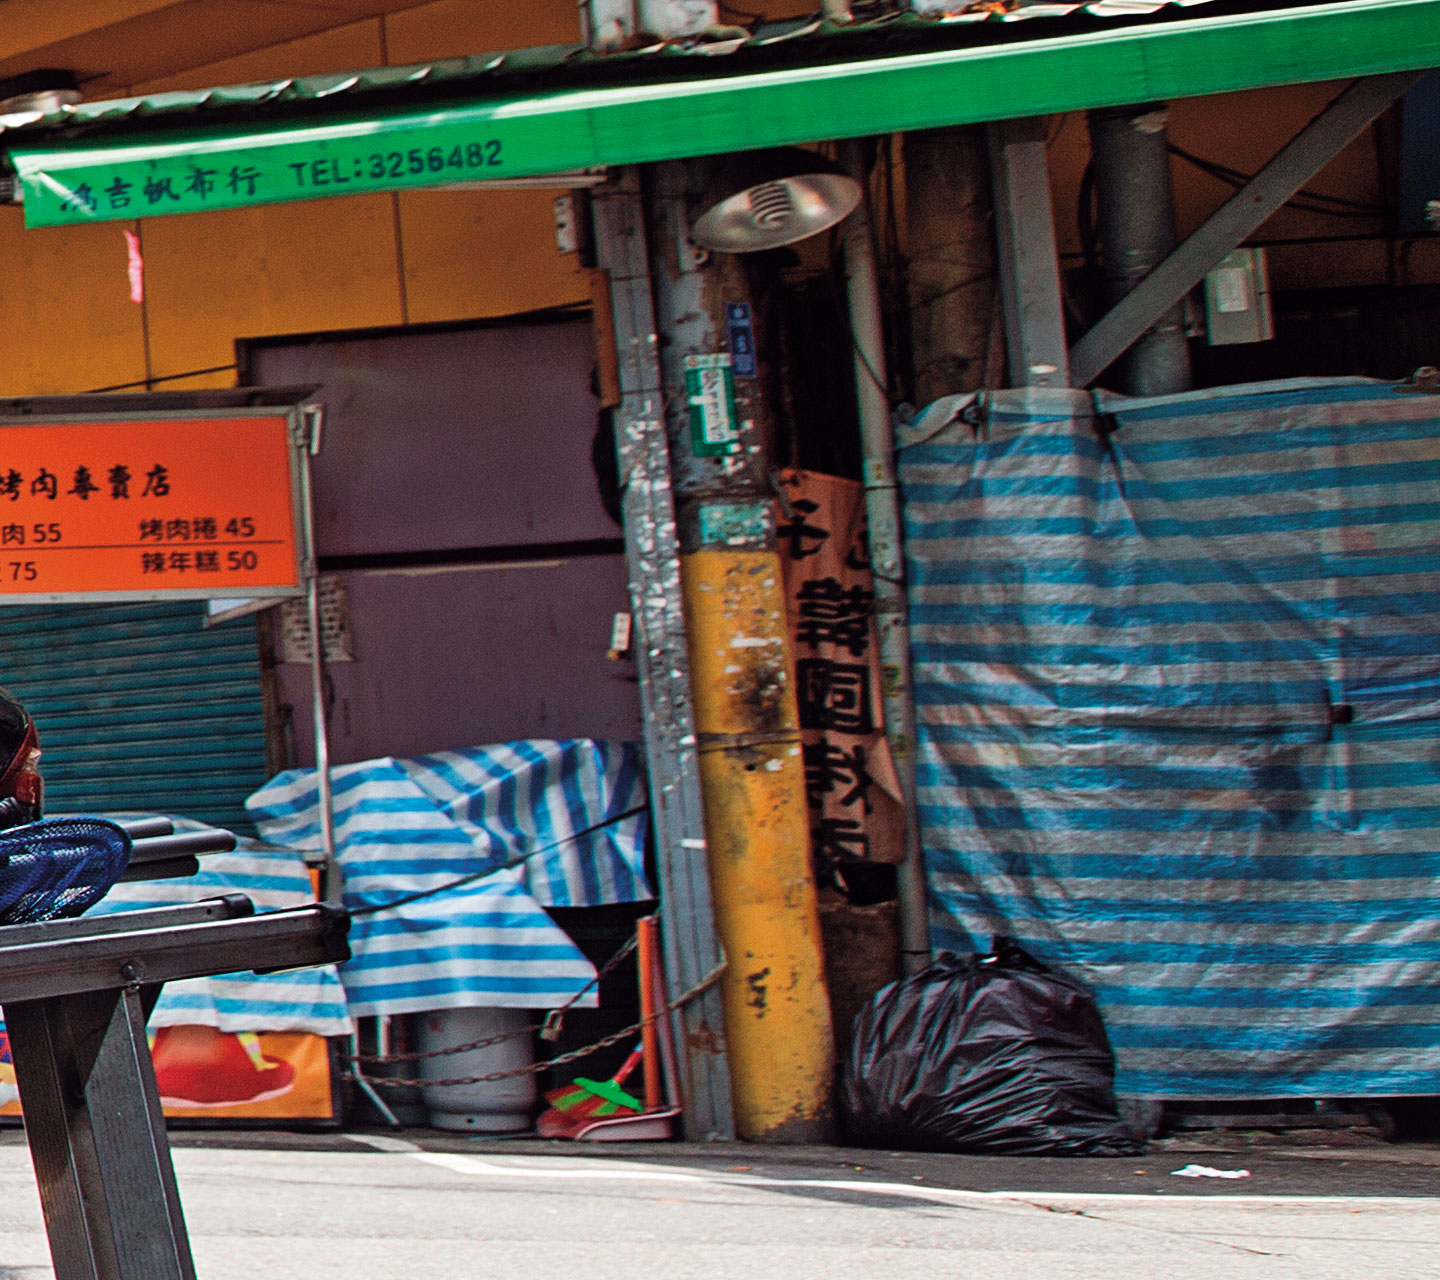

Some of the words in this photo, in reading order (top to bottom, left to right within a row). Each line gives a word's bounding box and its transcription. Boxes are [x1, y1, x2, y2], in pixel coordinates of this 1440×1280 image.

[289, 138, 504, 188] TEL:3256482
[33, 522, 62, 543] 55
[225, 516, 256, 538] 45
[8, 561, 39, 582] 75
[228, 550, 258, 572] 50
